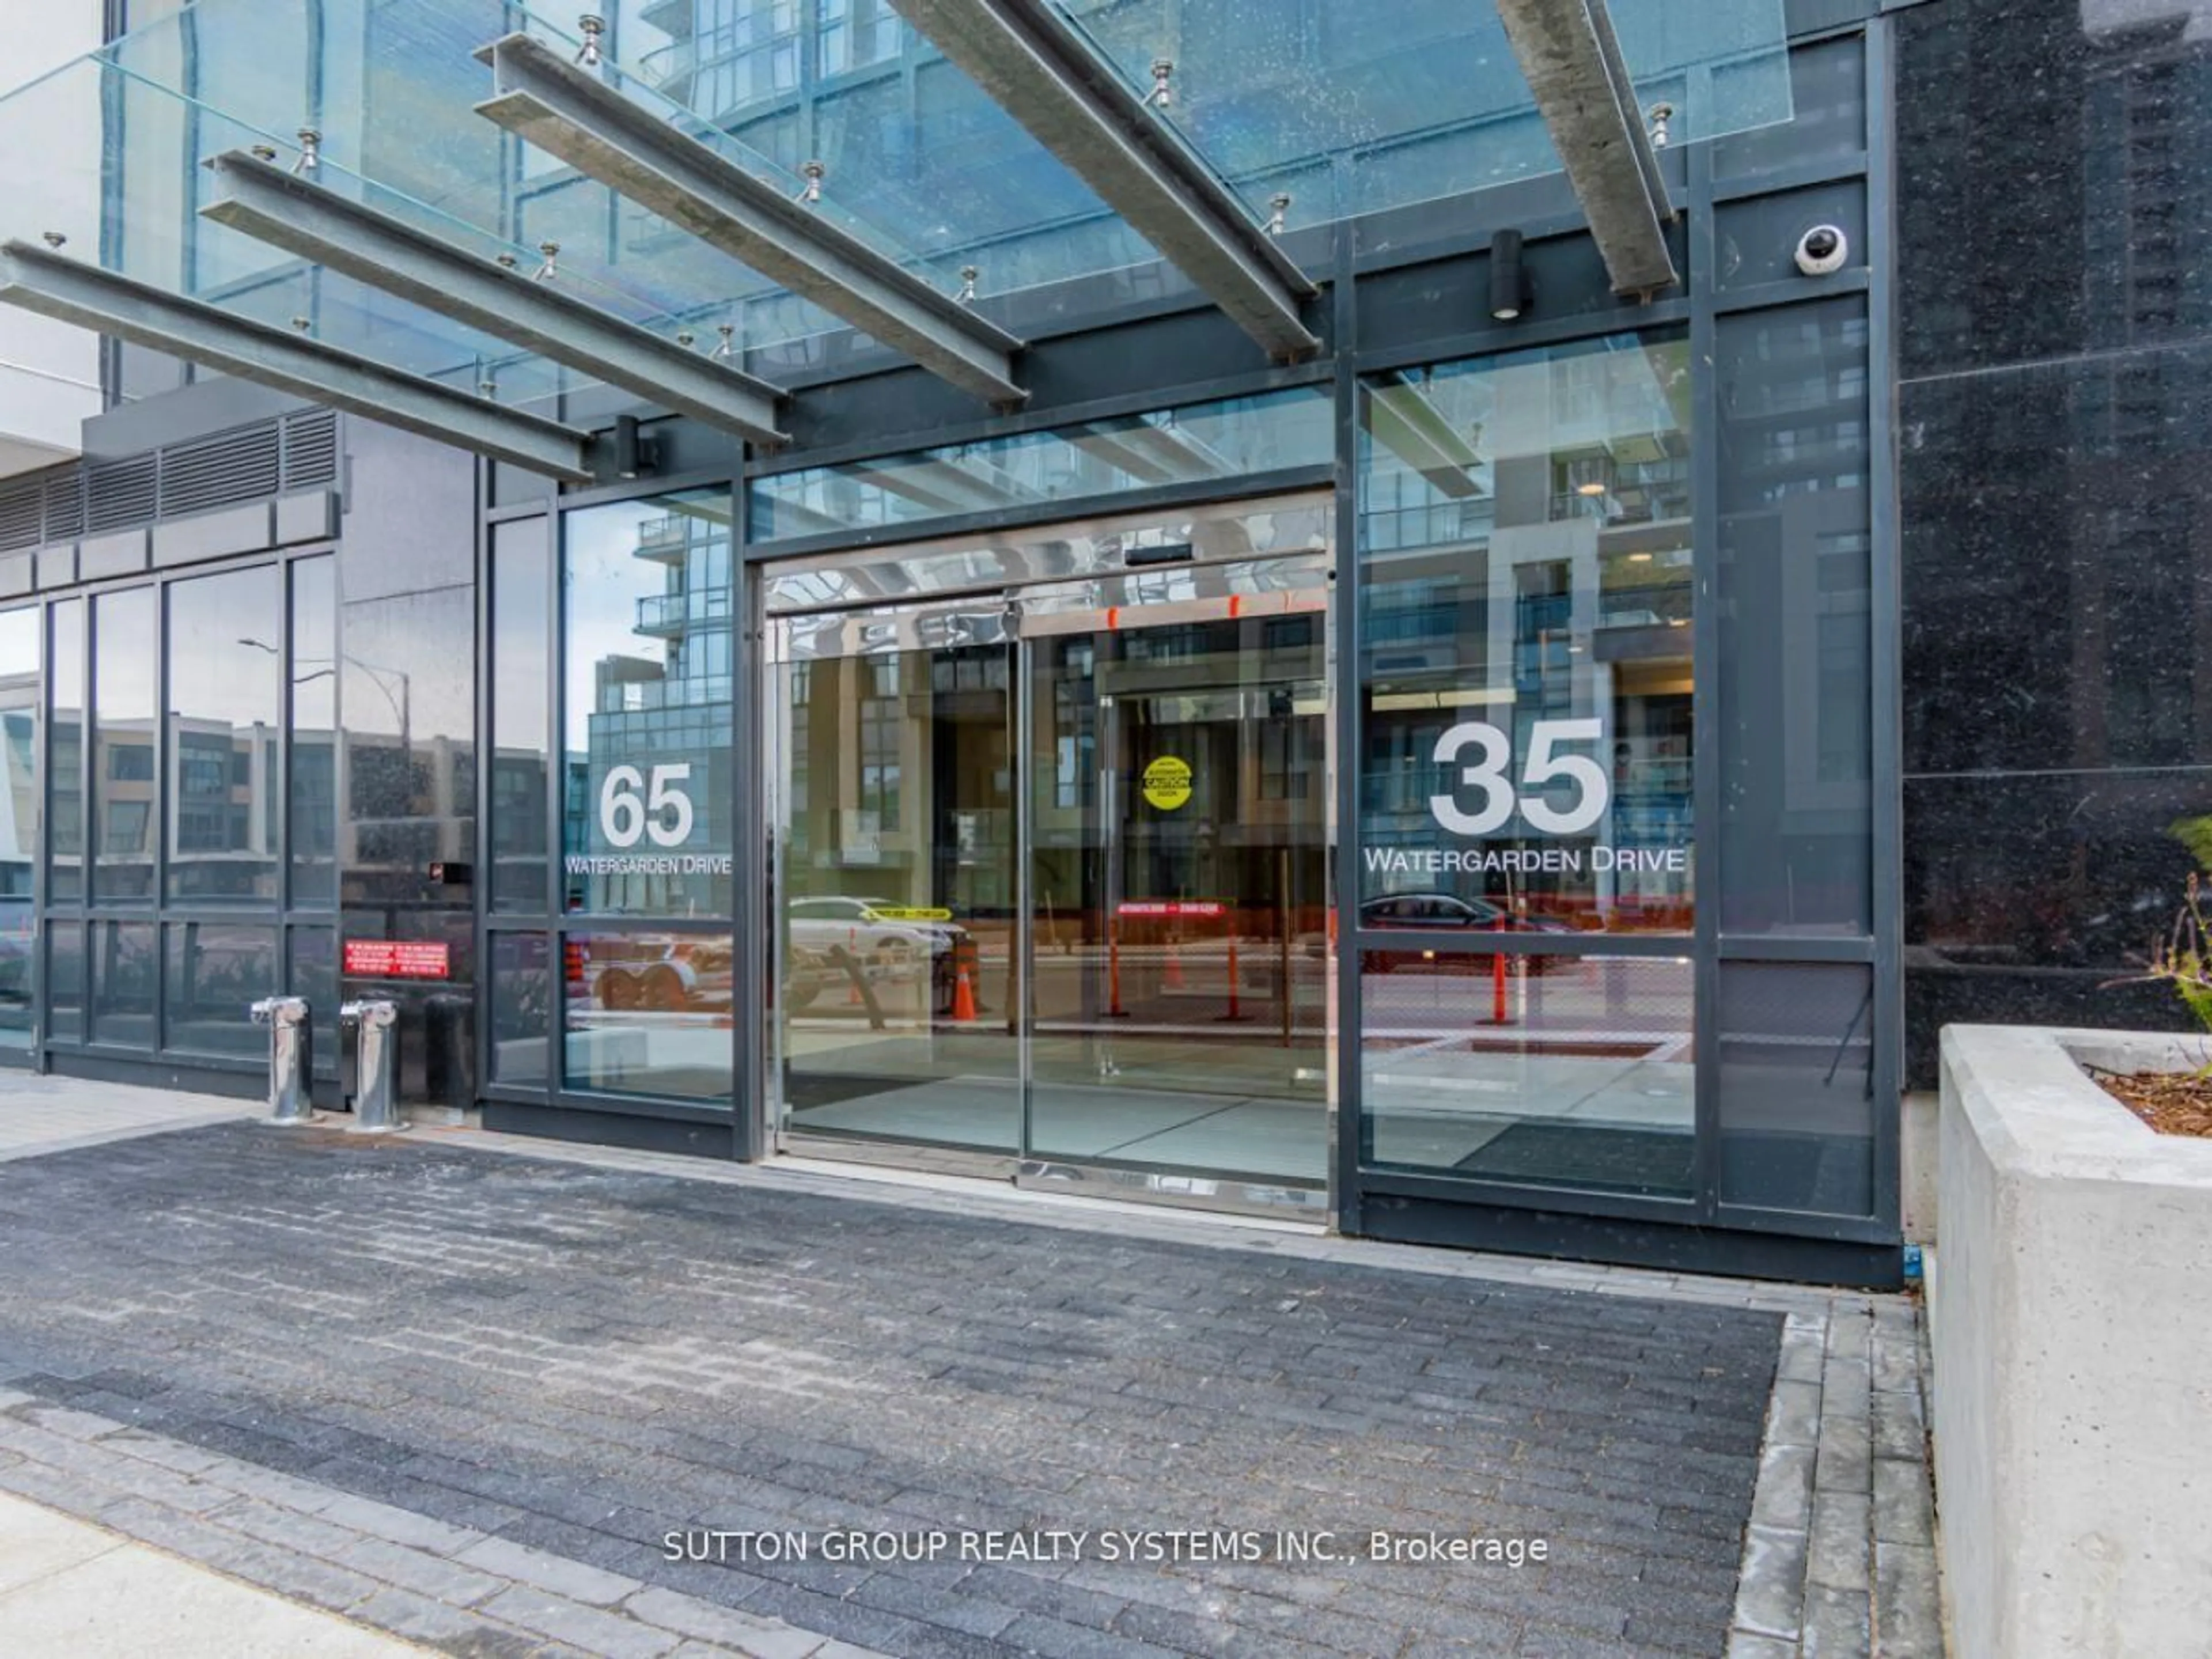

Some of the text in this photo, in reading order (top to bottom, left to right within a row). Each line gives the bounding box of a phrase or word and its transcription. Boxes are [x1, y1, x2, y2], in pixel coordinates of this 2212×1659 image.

[1430, 718, 1608, 836] 35
[600, 763, 693, 847] 65
[566, 855, 733, 875] WATERGARDEN DRIVE
[1364, 846, 1685, 873] WATERGARDEN DRIVE
